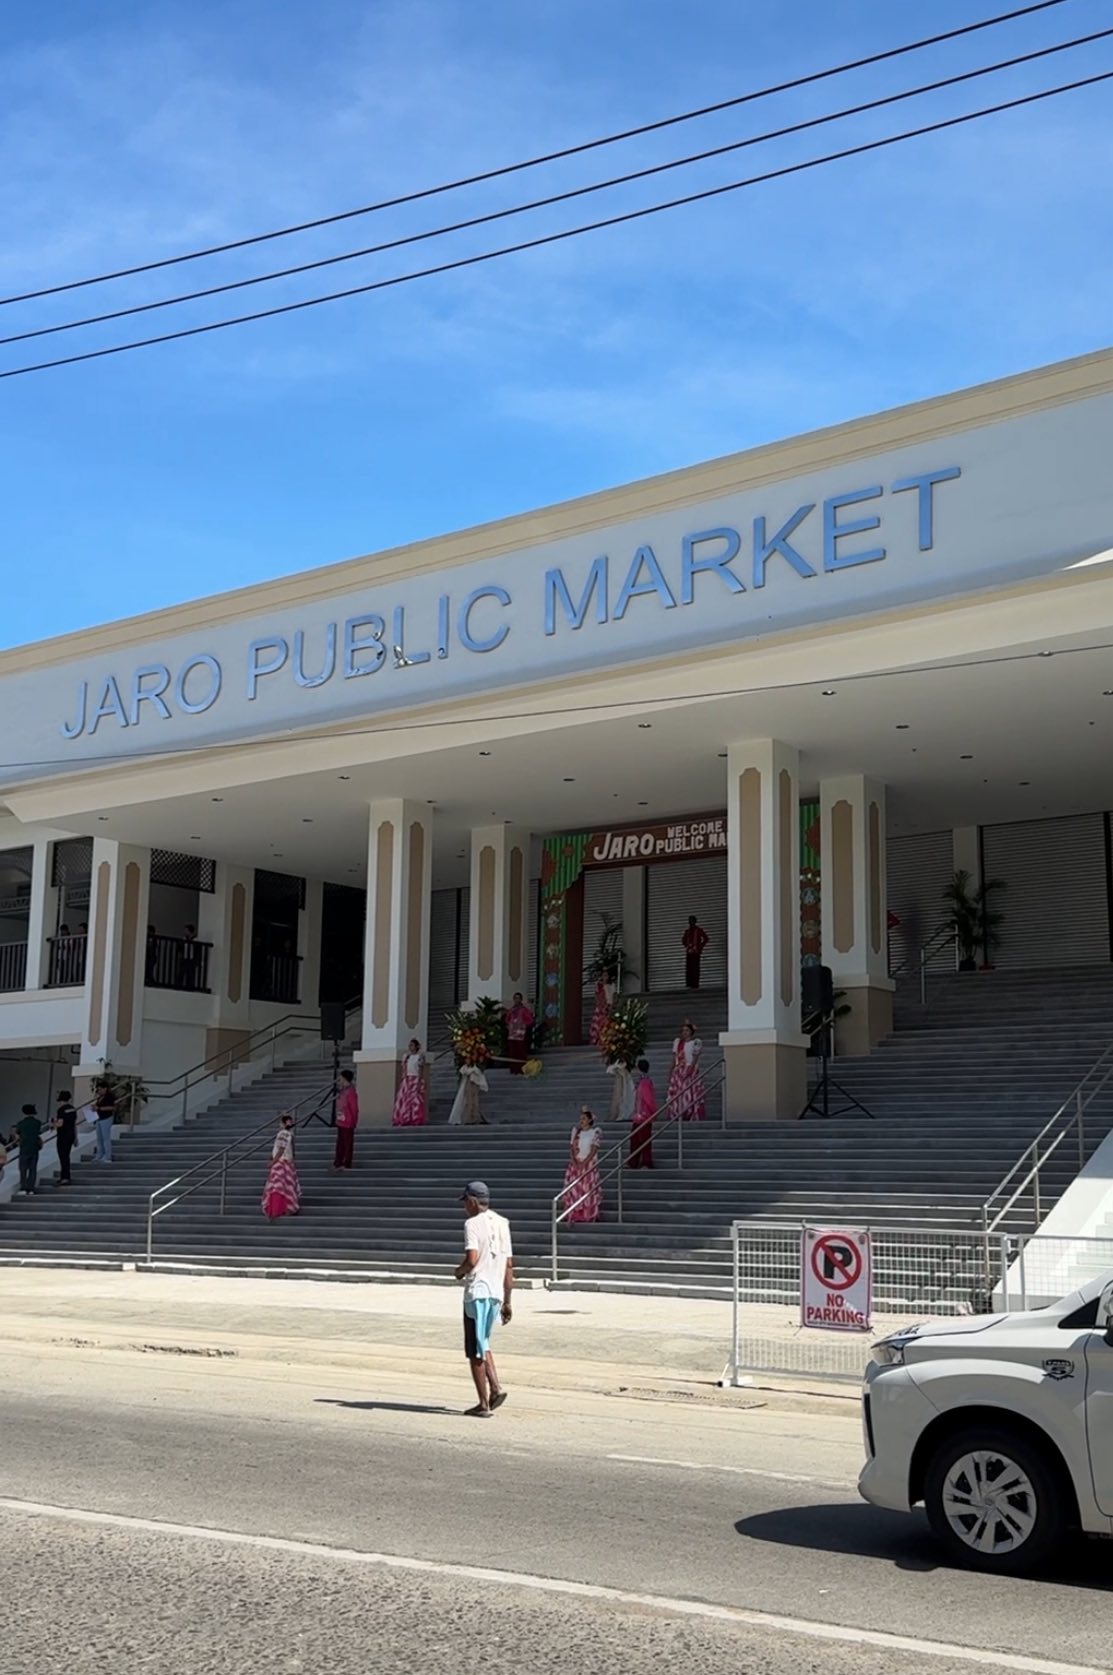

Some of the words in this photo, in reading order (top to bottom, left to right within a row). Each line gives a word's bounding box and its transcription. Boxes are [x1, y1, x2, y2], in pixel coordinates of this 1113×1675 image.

[61, 652, 223, 740] JARO
[246, 585, 512, 702] PUBLIC
[544, 466, 961, 636] MARKET
[667, 820, 723, 838] WELCOME
[593, 832, 655, 860] JARO
[656, 836, 704, 854] PUBLIC
[708, 831, 728, 848] MA
[826, 1293, 845, 1307] NO
[807, 1306, 865, 1324] PARKING
